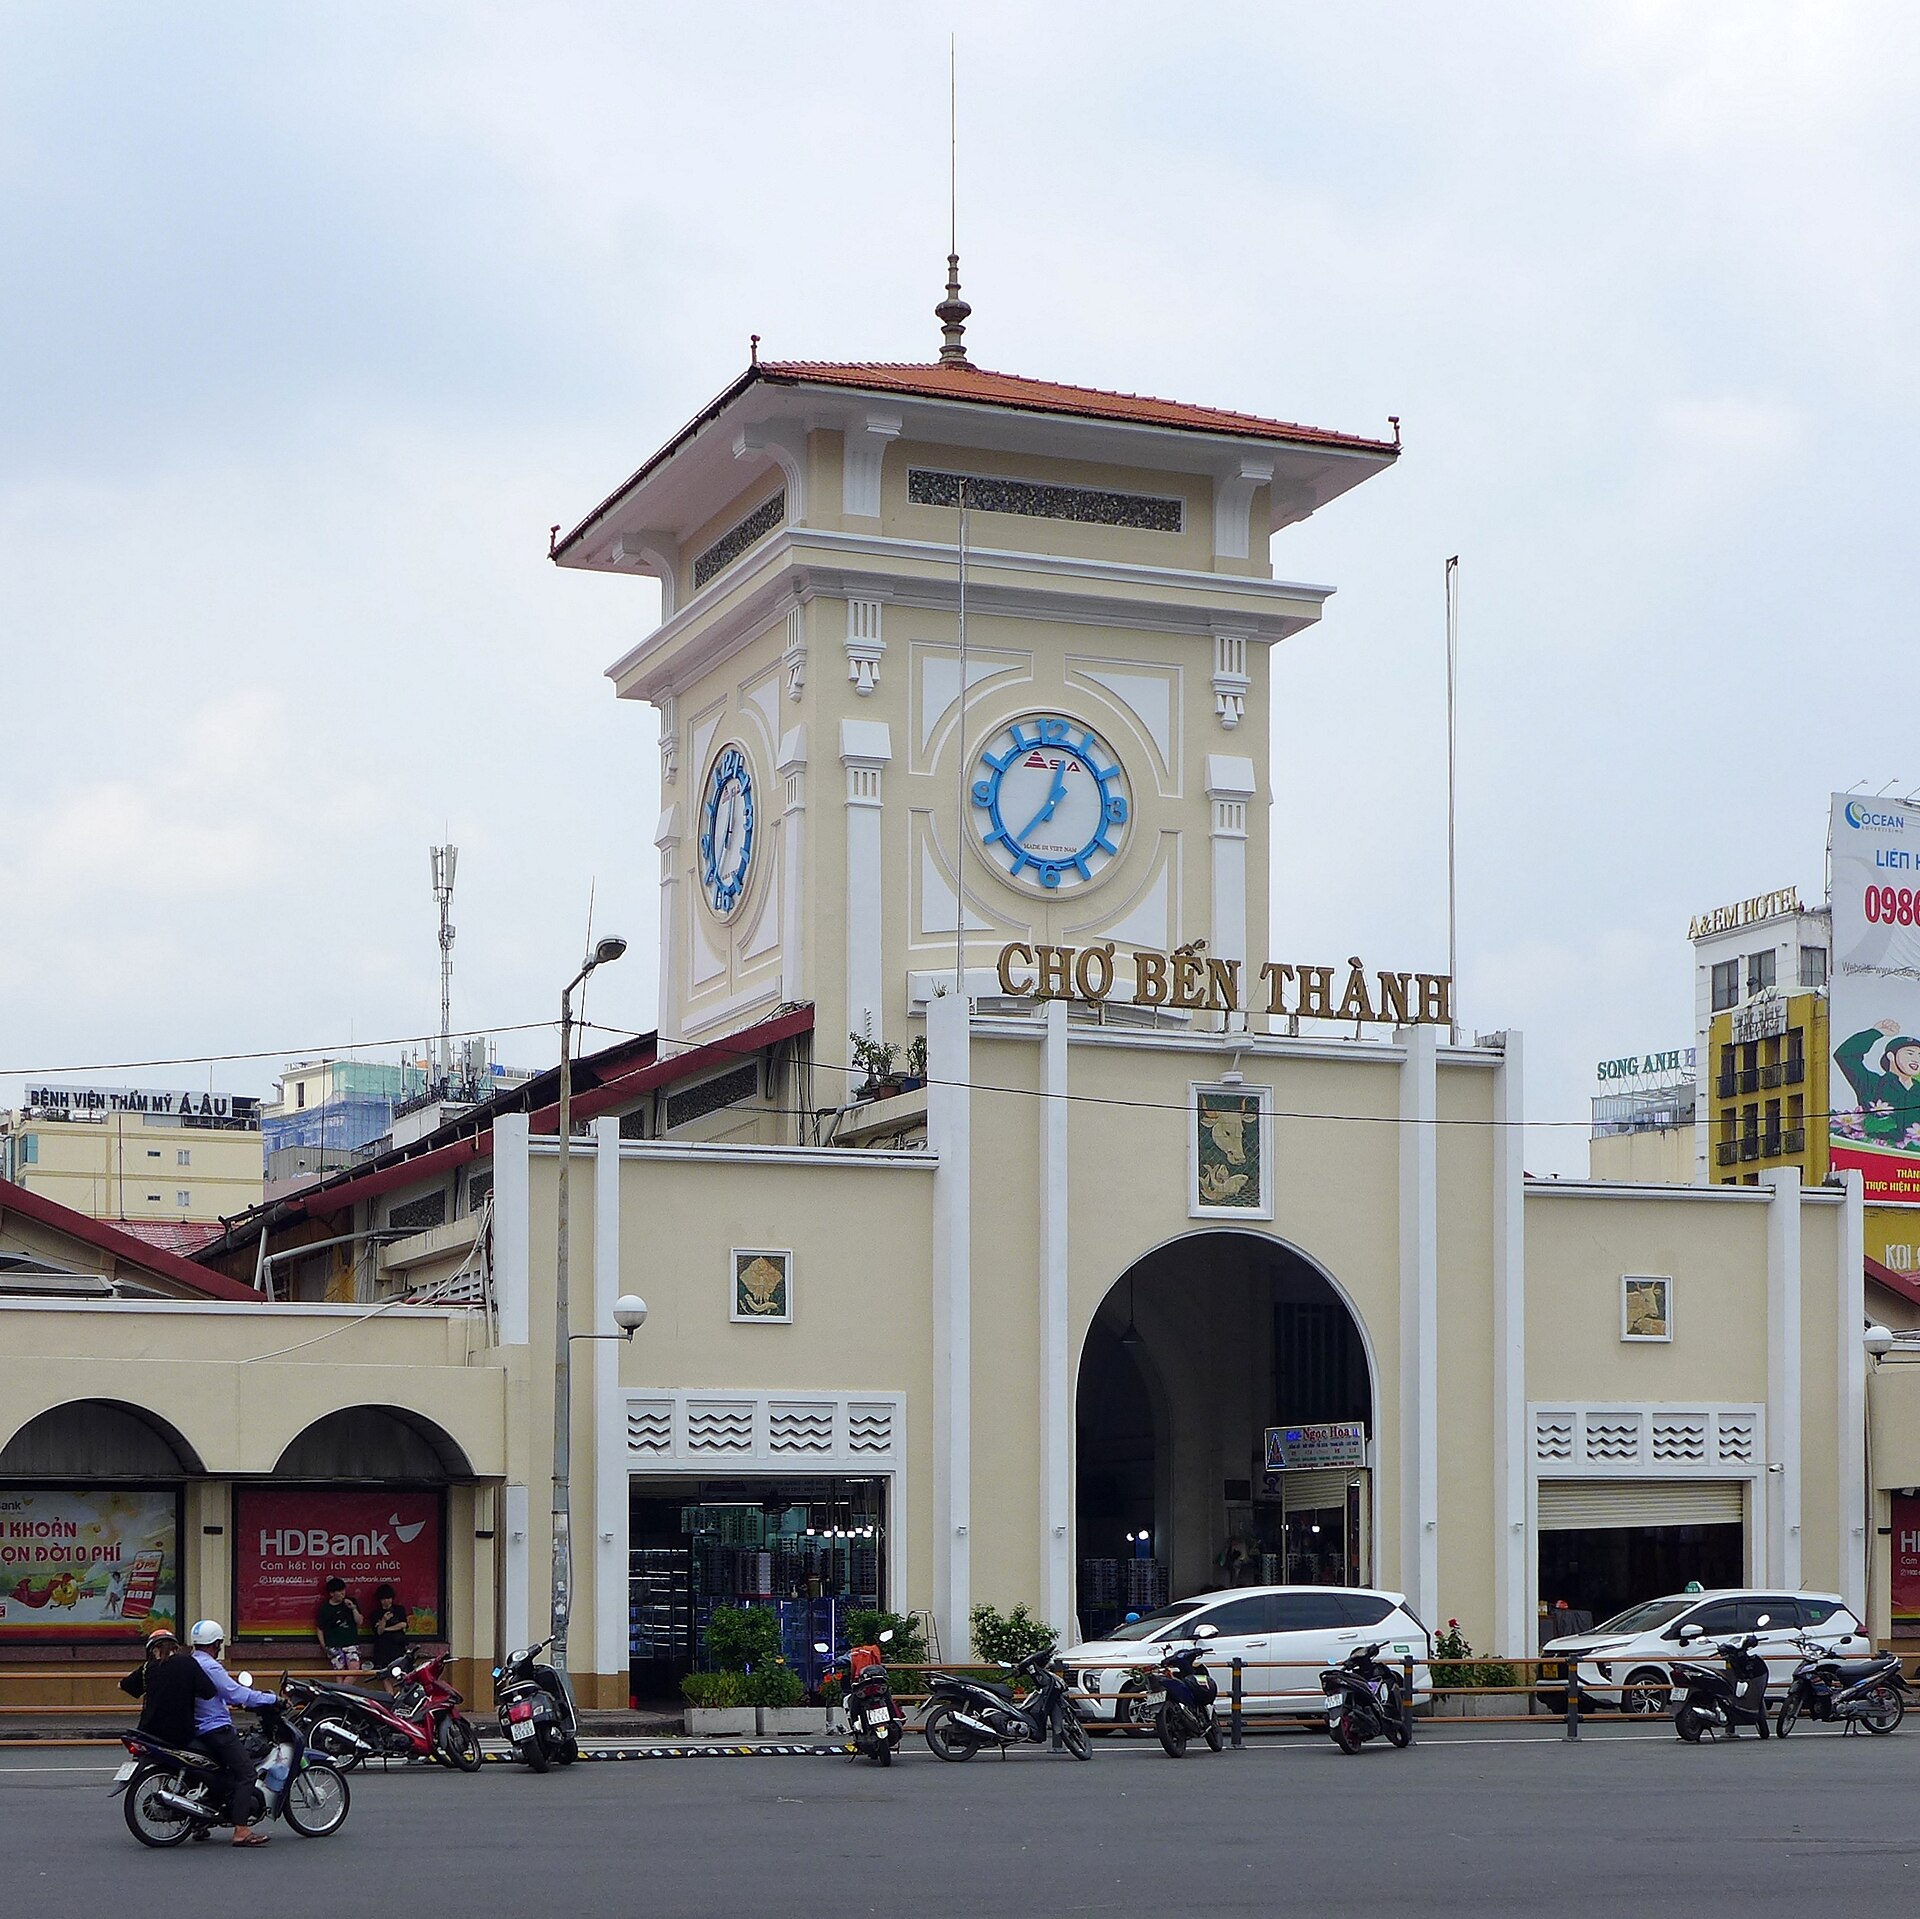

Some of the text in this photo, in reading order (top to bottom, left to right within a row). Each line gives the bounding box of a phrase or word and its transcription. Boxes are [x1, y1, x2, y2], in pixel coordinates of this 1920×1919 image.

[1023, 751, 1081, 772] ASA
[1861, 813, 1904, 829] OCEAN
[1687, 885, 1799, 940] A&EM HOTEL
[997, 939, 1453, 1024] CHỢ BẾN THÀNH
[1597, 1056, 1640, 1081] SONG
[1641, 1050, 1680, 1075] ANH
[30, 1087, 227, 1116] BỆNH VIỆN THẨM MỸ Á-ÂU
[1865, 1181, 1888, 1193] THỰC
[1889, 1180, 1911, 1194] HIỆN
[10, 1516, 77, 1538] KHOẢN
[35, 1543, 71, 1562] ĐỜI
[92, 1542, 122, 1562] PHÍ
[260, 1529, 389, 1556] HDBank
[260, 1560, 400, 1571] Cam kết lợi ích cao nhất
[1901, 1556, 1917, 1565] Cam
